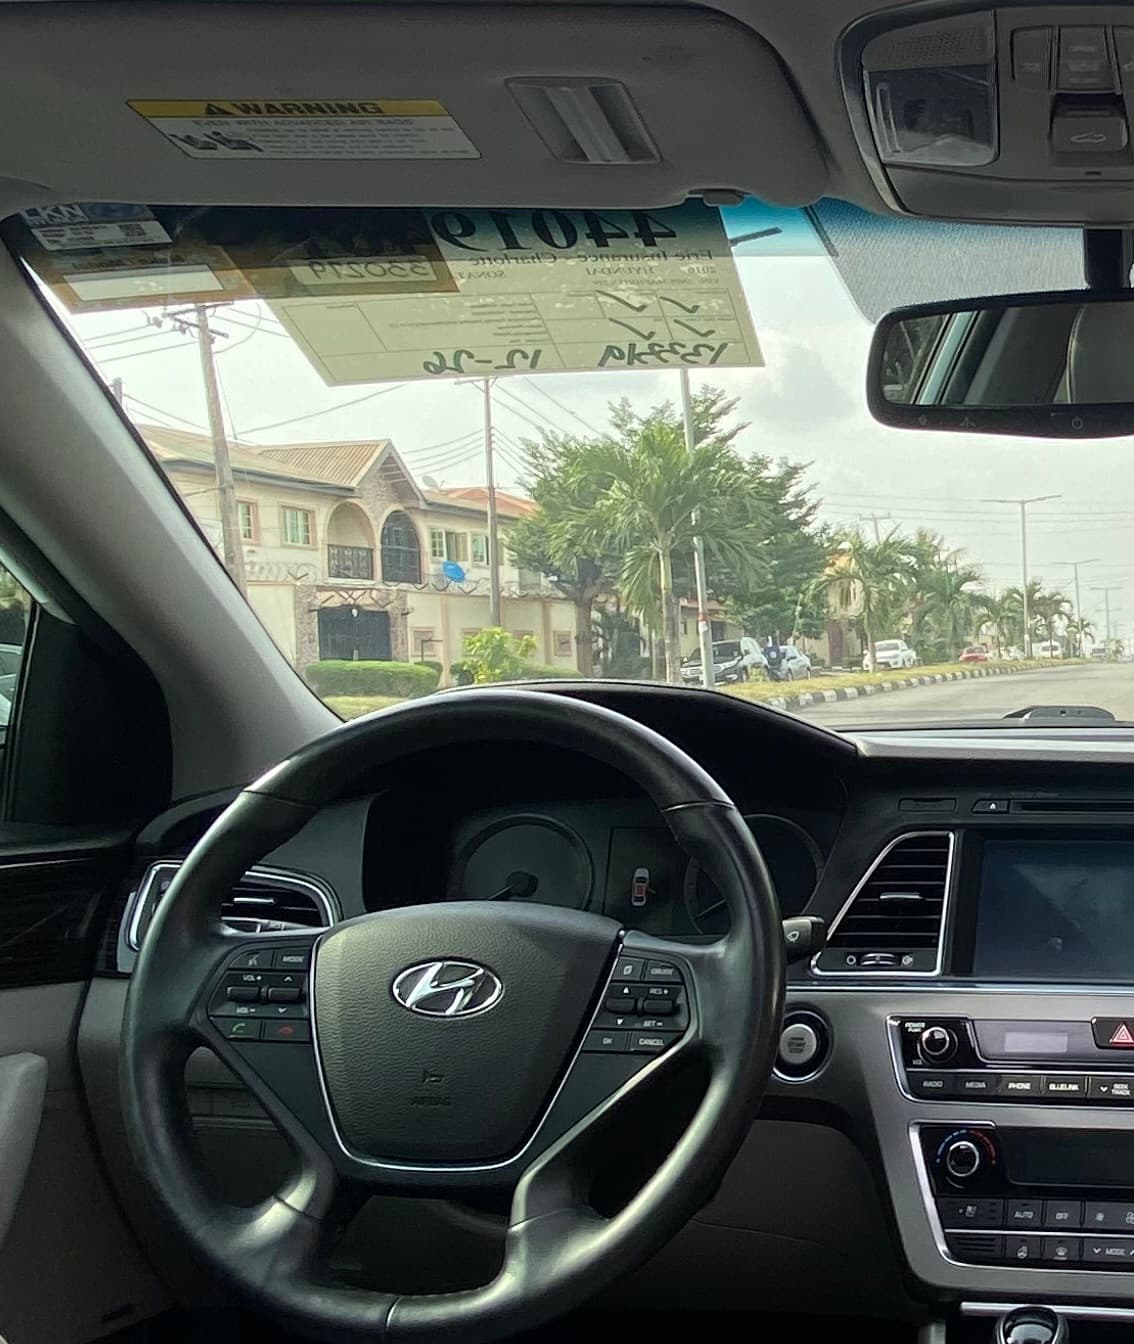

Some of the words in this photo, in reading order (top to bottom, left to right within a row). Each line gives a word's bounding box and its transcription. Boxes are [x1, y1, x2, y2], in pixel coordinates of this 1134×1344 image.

[231, 102, 384, 115] WARNING
[639, 1038, 665, 1046] CANCEL
[922, 1080, 944, 1088] RADIO
[965, 1081, 987, 1089] MEDIA
[1013, 1211, 1034, 1219] AUTO
[1105, 1248, 1125, 1256] MODE
